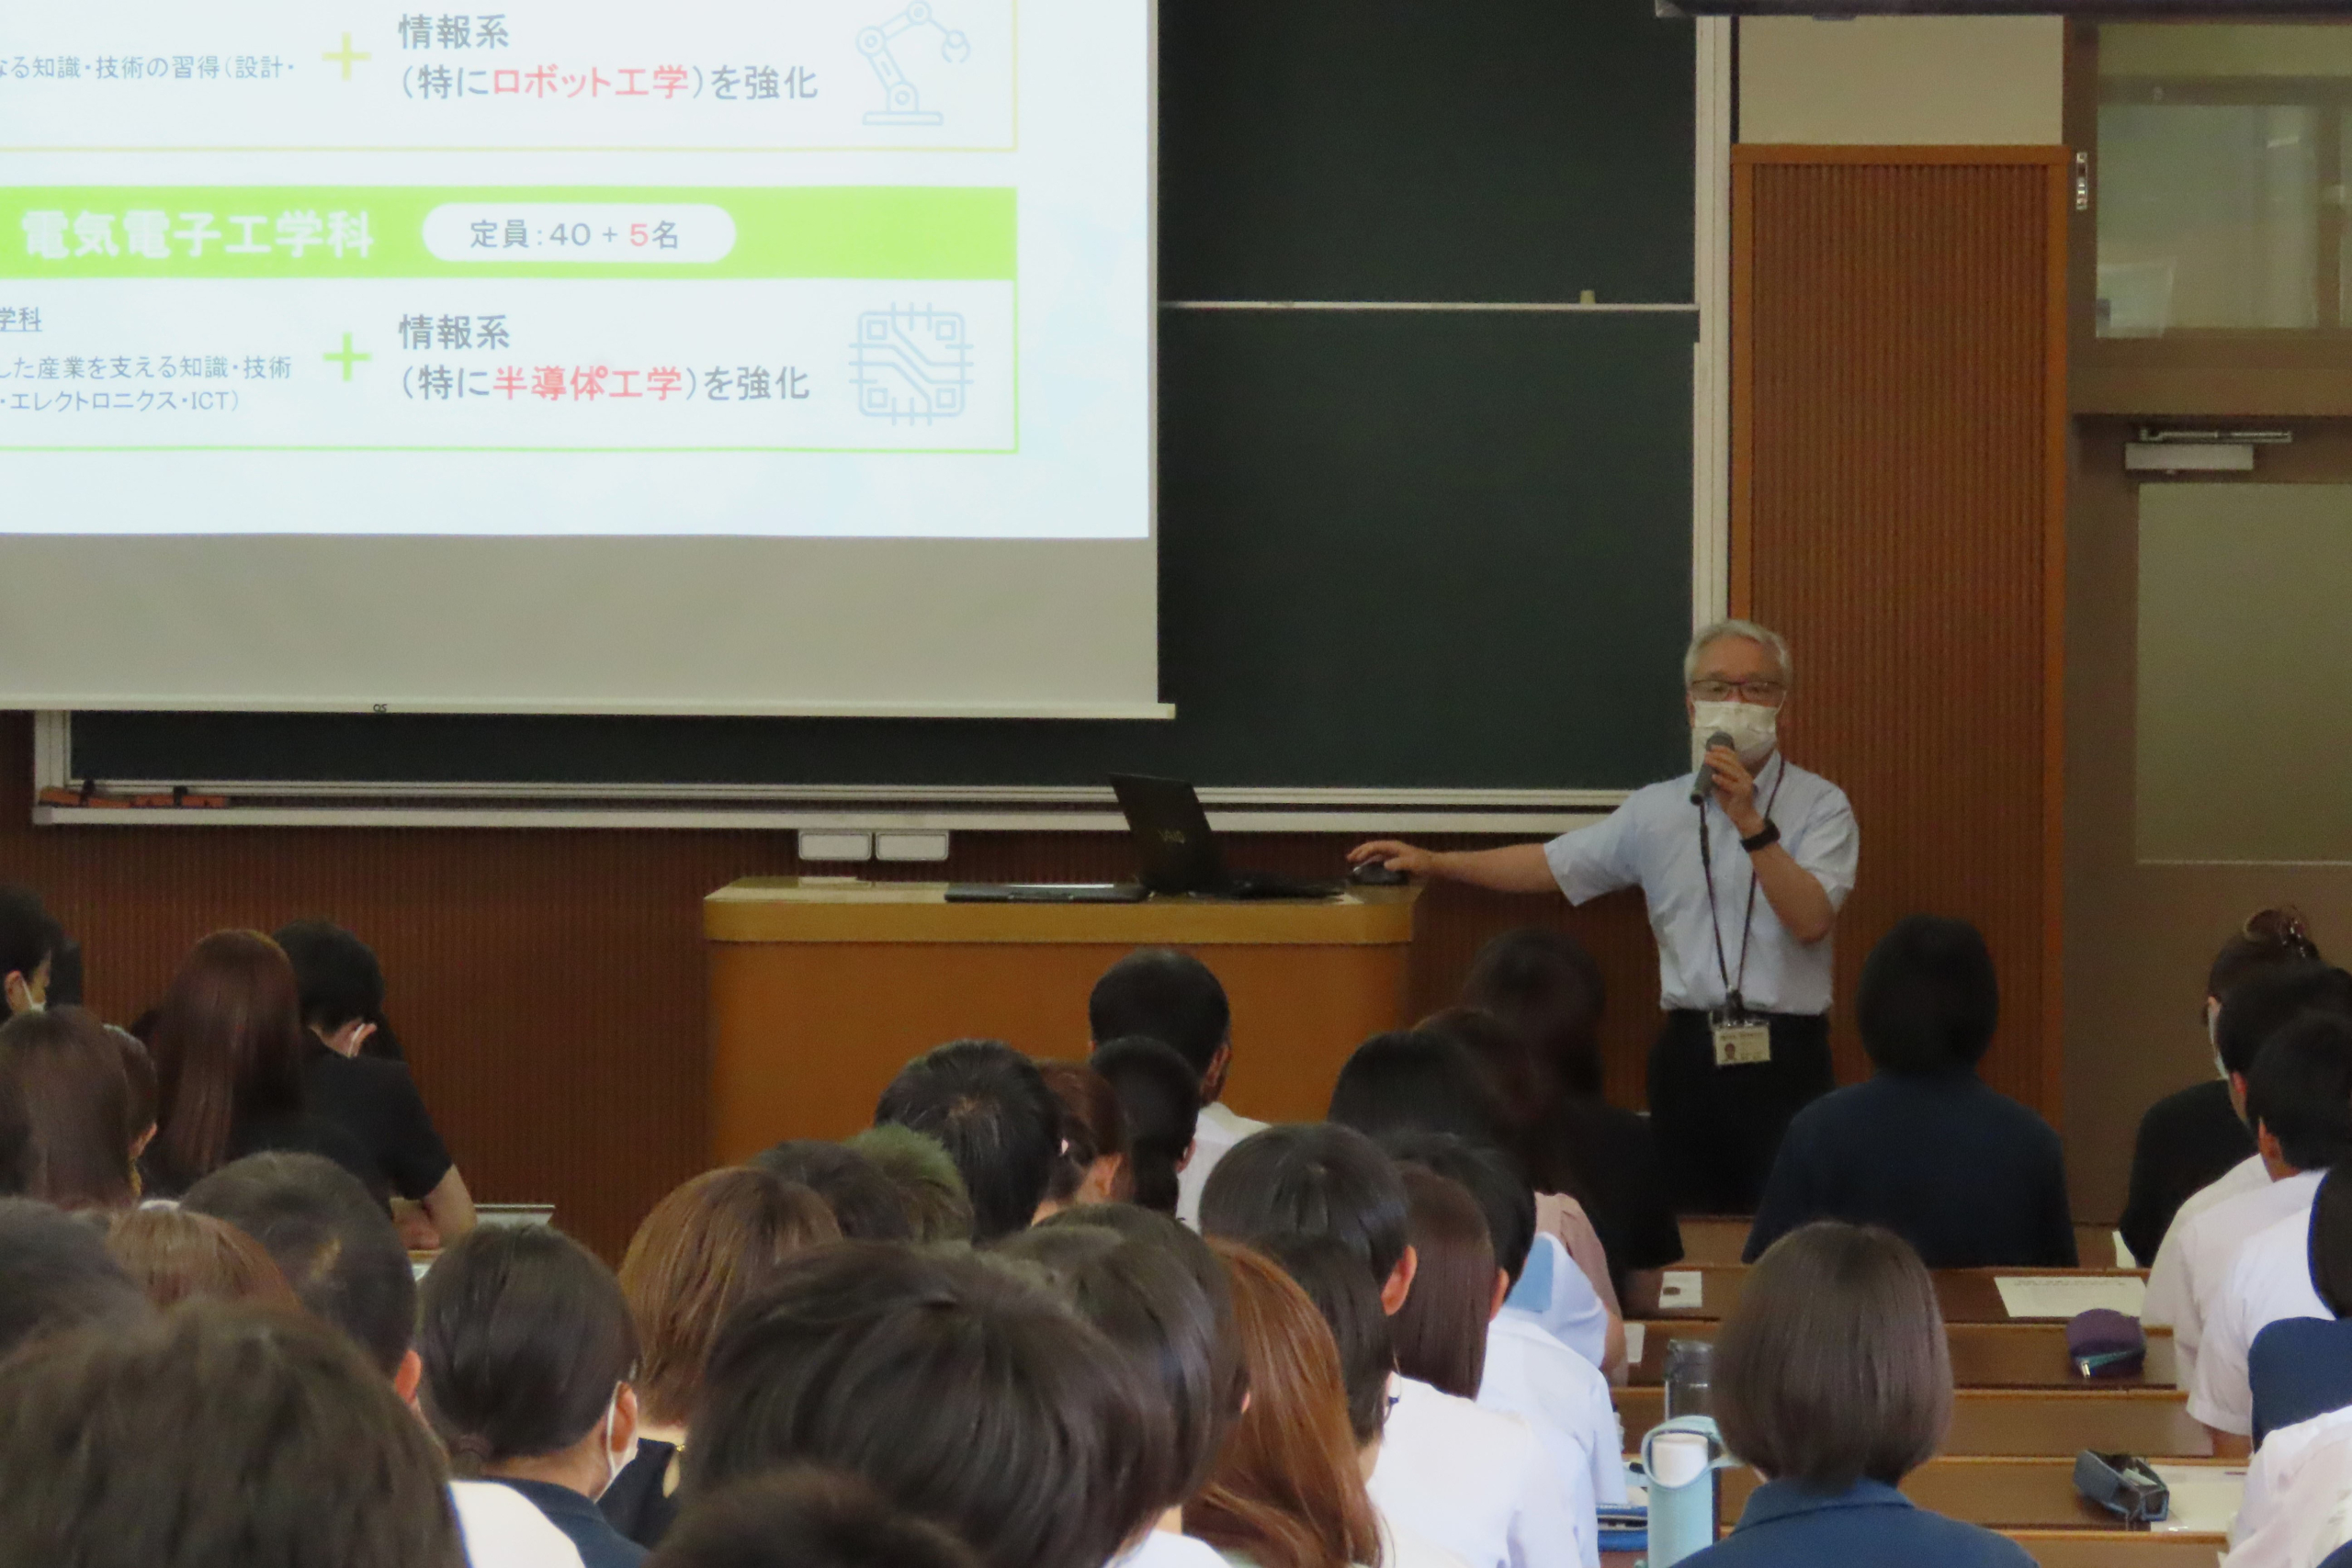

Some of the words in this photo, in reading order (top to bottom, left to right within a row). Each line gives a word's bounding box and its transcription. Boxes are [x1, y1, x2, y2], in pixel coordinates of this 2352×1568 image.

[397, 13, 510, 51] 情報系
[21, 209, 375, 259] 電気電子工学科
[398, 313, 511, 351] 情報系
